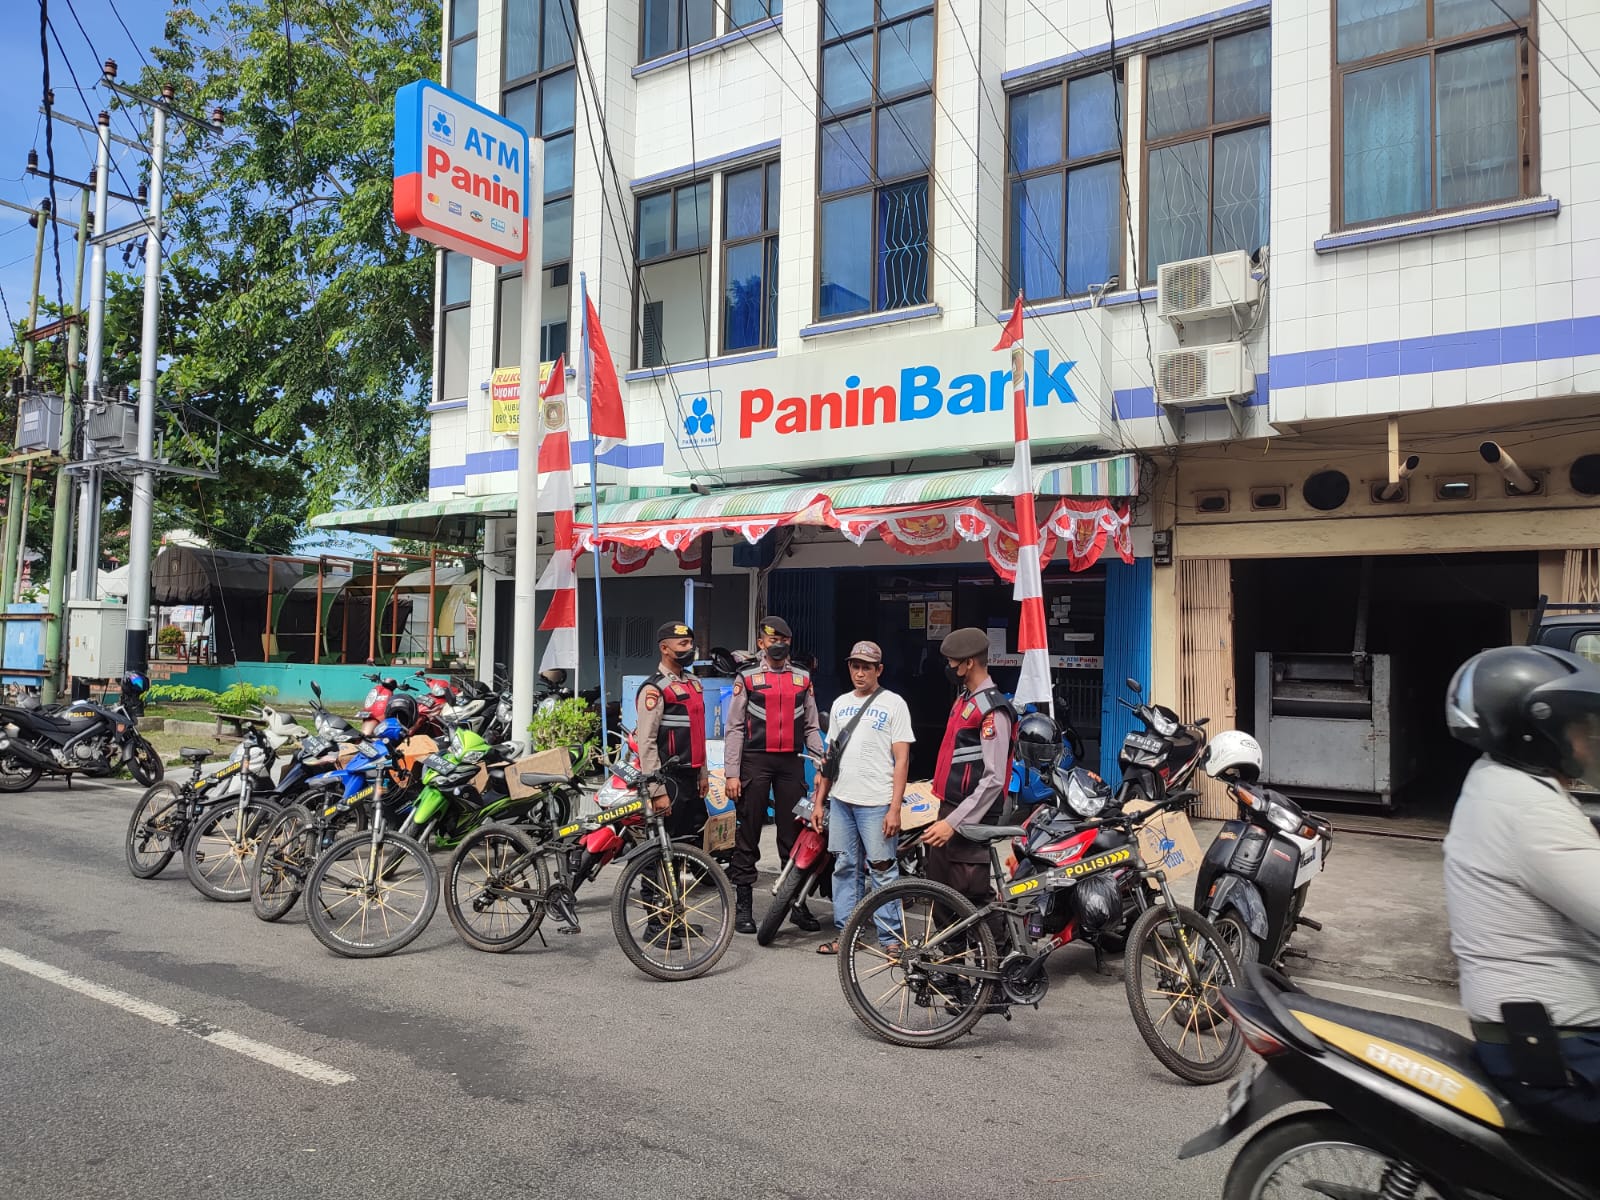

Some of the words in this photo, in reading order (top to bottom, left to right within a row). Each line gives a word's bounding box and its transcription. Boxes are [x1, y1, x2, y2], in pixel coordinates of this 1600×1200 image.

[464, 126, 519, 174] ATM
[427, 144, 519, 214] Panin
[597, 805, 628, 823] POLISI
[1065, 855, 1110, 878] POLISI
[1365, 1043, 1464, 1101] BRIDE
